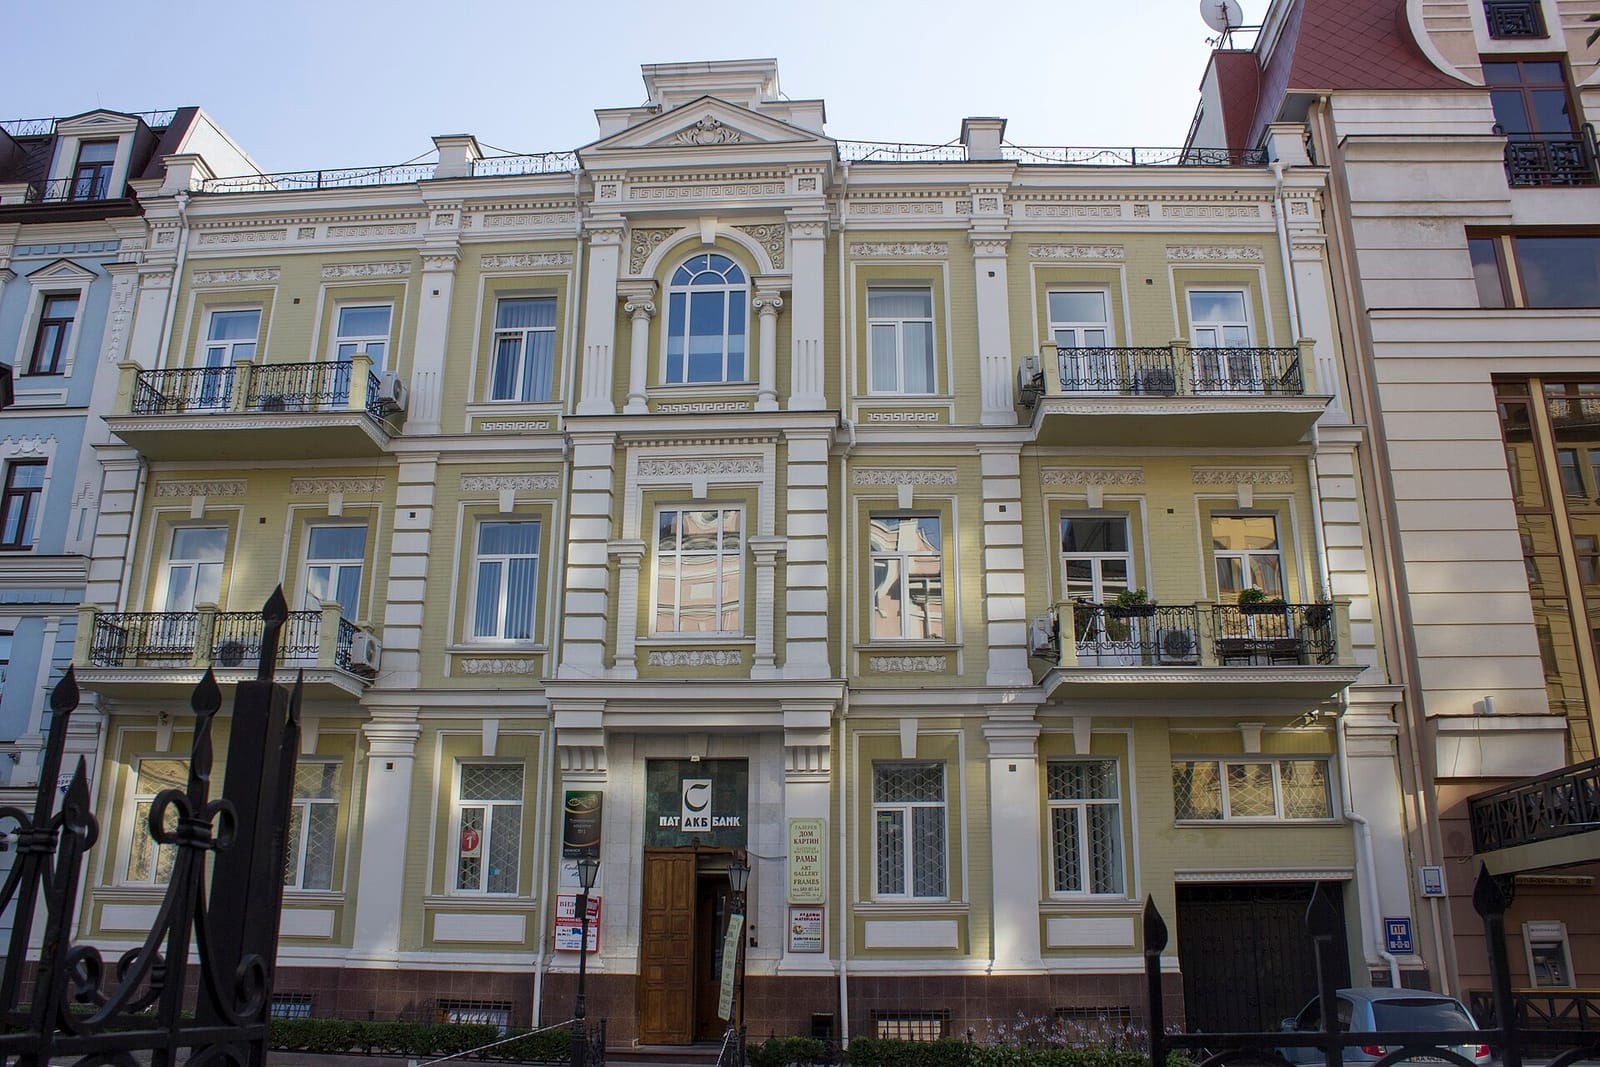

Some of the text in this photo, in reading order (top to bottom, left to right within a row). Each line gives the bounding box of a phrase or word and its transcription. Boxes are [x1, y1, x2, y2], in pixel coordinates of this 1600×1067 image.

[659, 816, 740, 827] ПАТ АКБ БАНК
[798, 830, 814, 838] ДОМ
